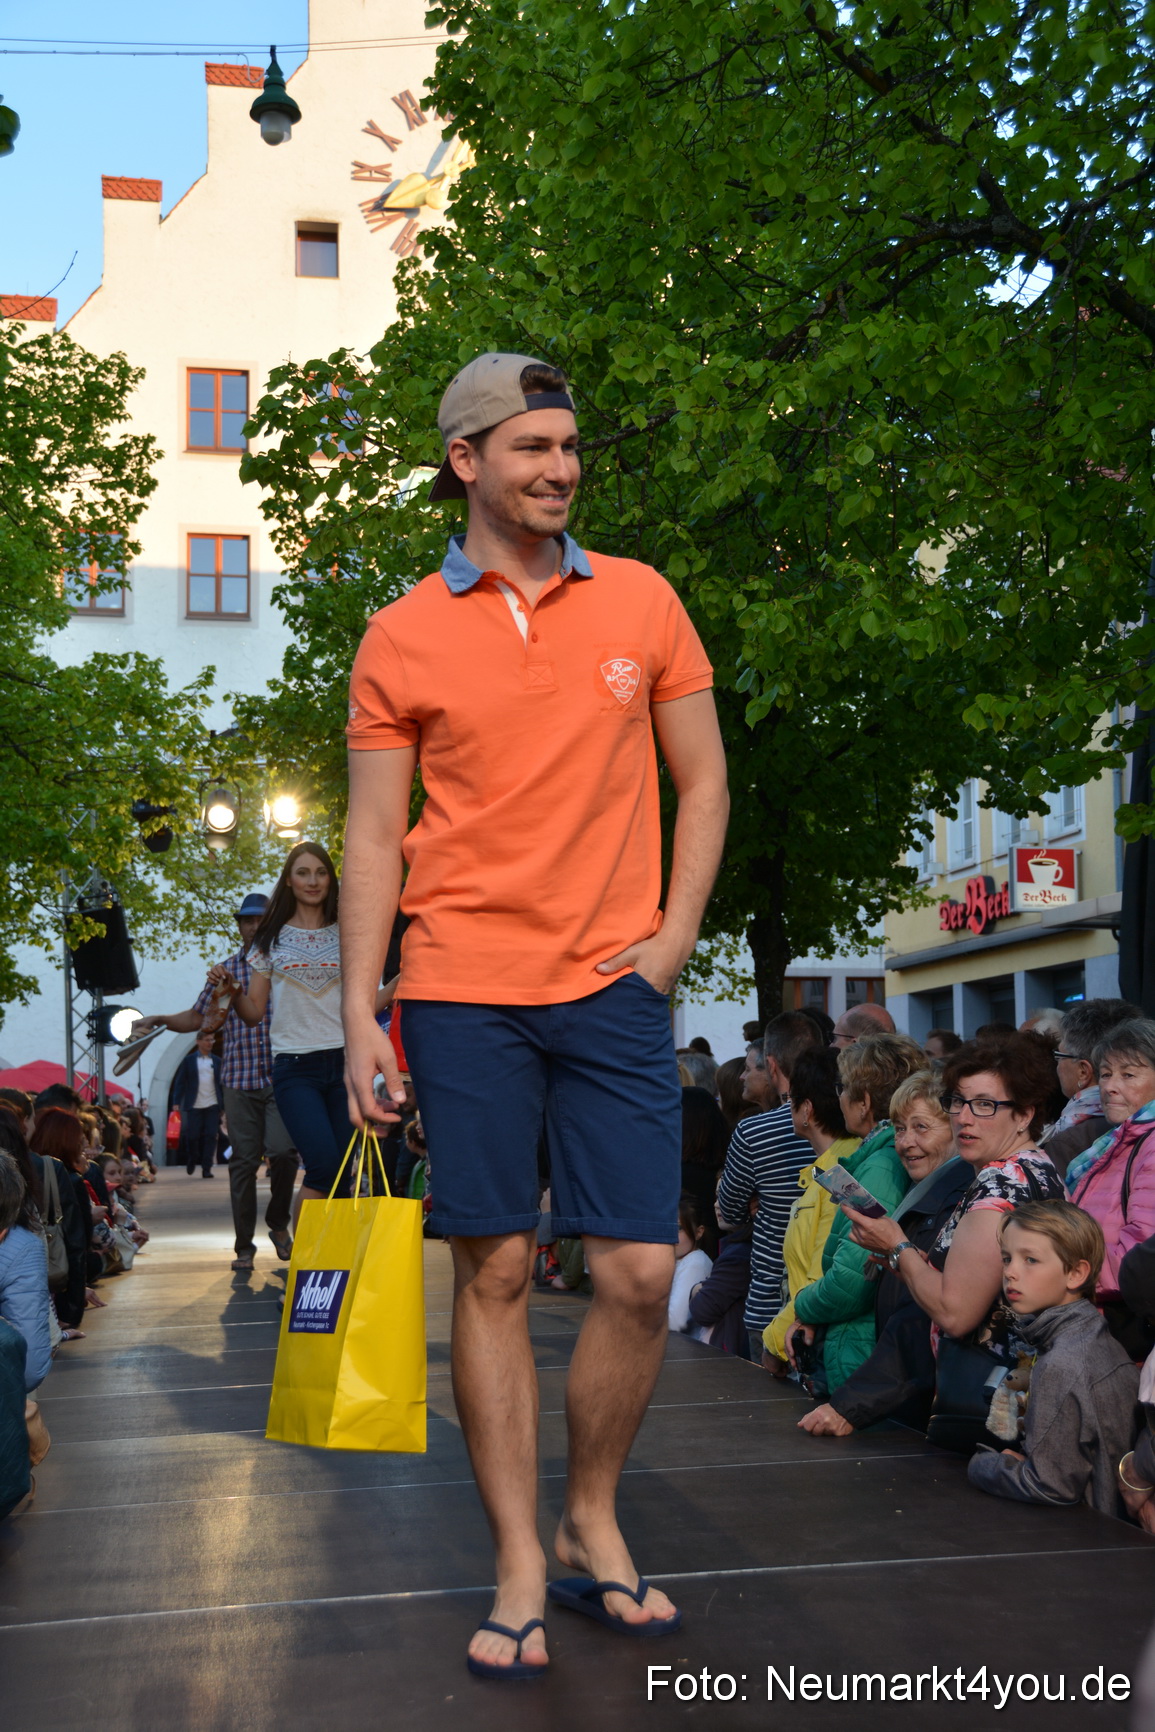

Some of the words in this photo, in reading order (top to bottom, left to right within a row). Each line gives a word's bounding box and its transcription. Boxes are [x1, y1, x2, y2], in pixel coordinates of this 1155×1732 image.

[361, 119, 403, 152] X
[939, 901, 964, 931] Der
[965, 875, 1010, 935] Beck
[1022, 892, 1039, 902] Der
[1039, 889, 1067, 904] Beck
